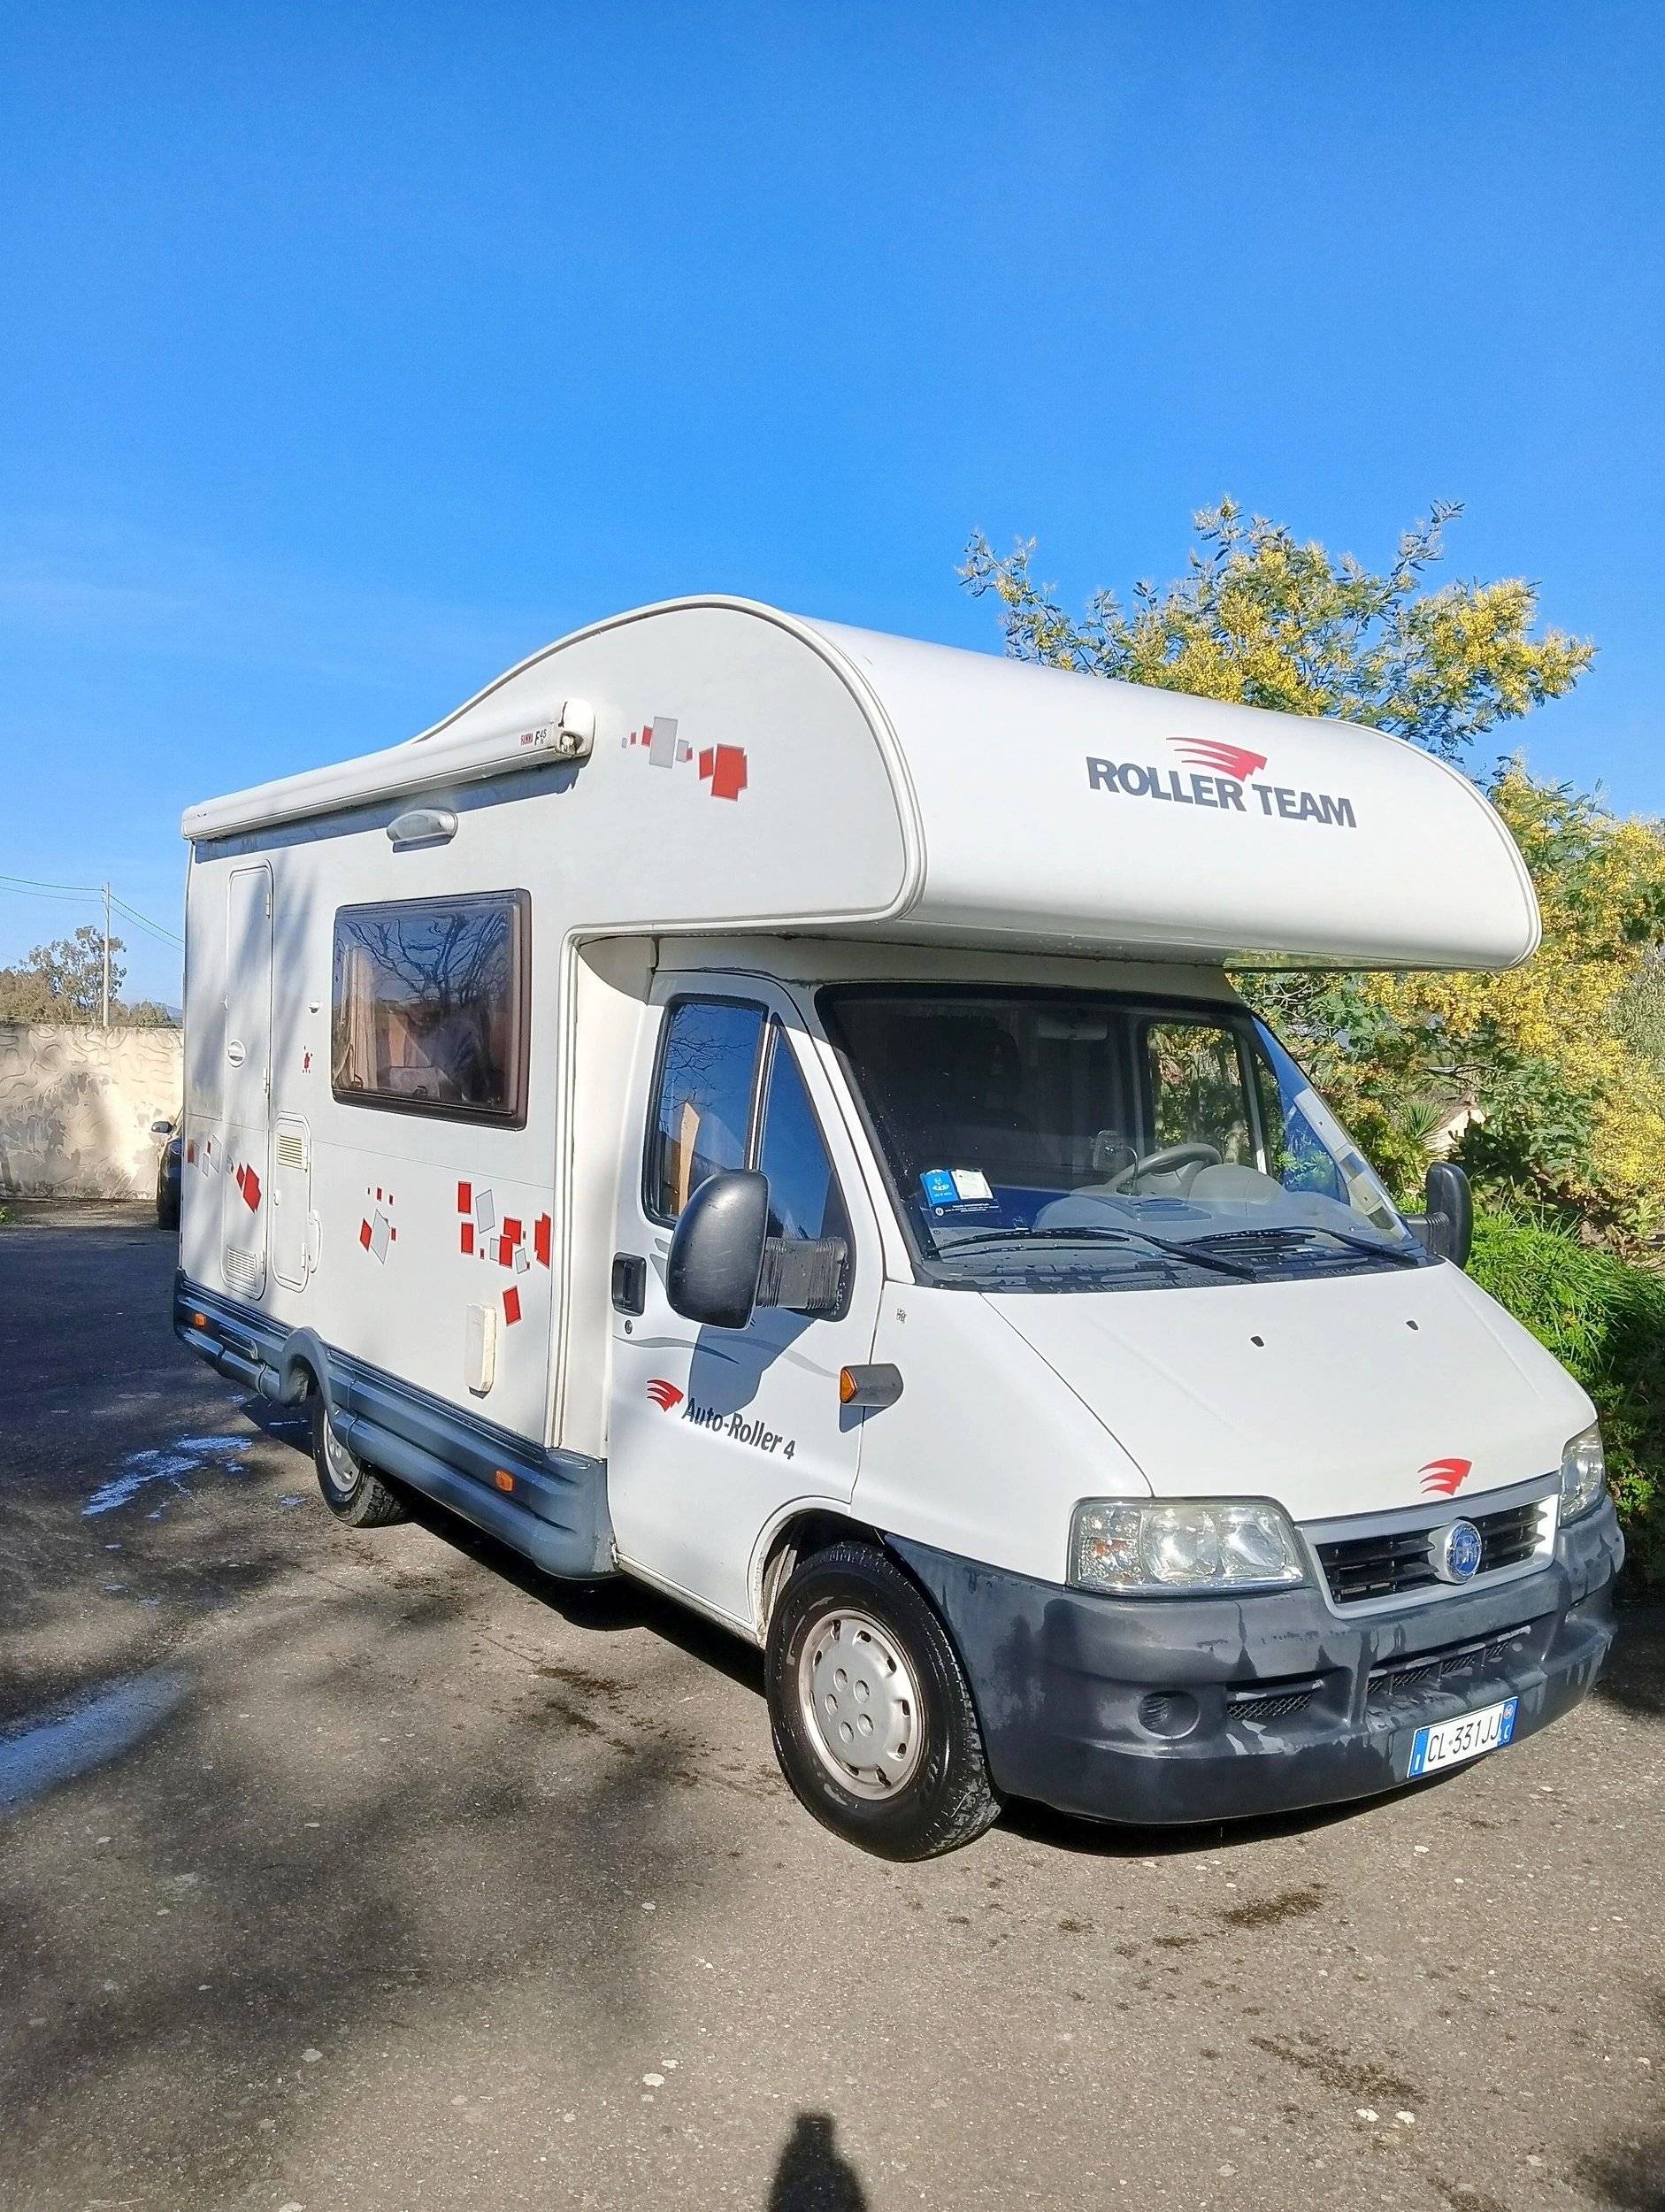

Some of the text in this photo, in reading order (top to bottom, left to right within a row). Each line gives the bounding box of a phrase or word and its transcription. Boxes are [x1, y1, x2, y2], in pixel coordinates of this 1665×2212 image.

[1086, 757, 1357, 828] ROLLER TEAM
[681, 1397, 796, 1460] Auto-Roller 4
